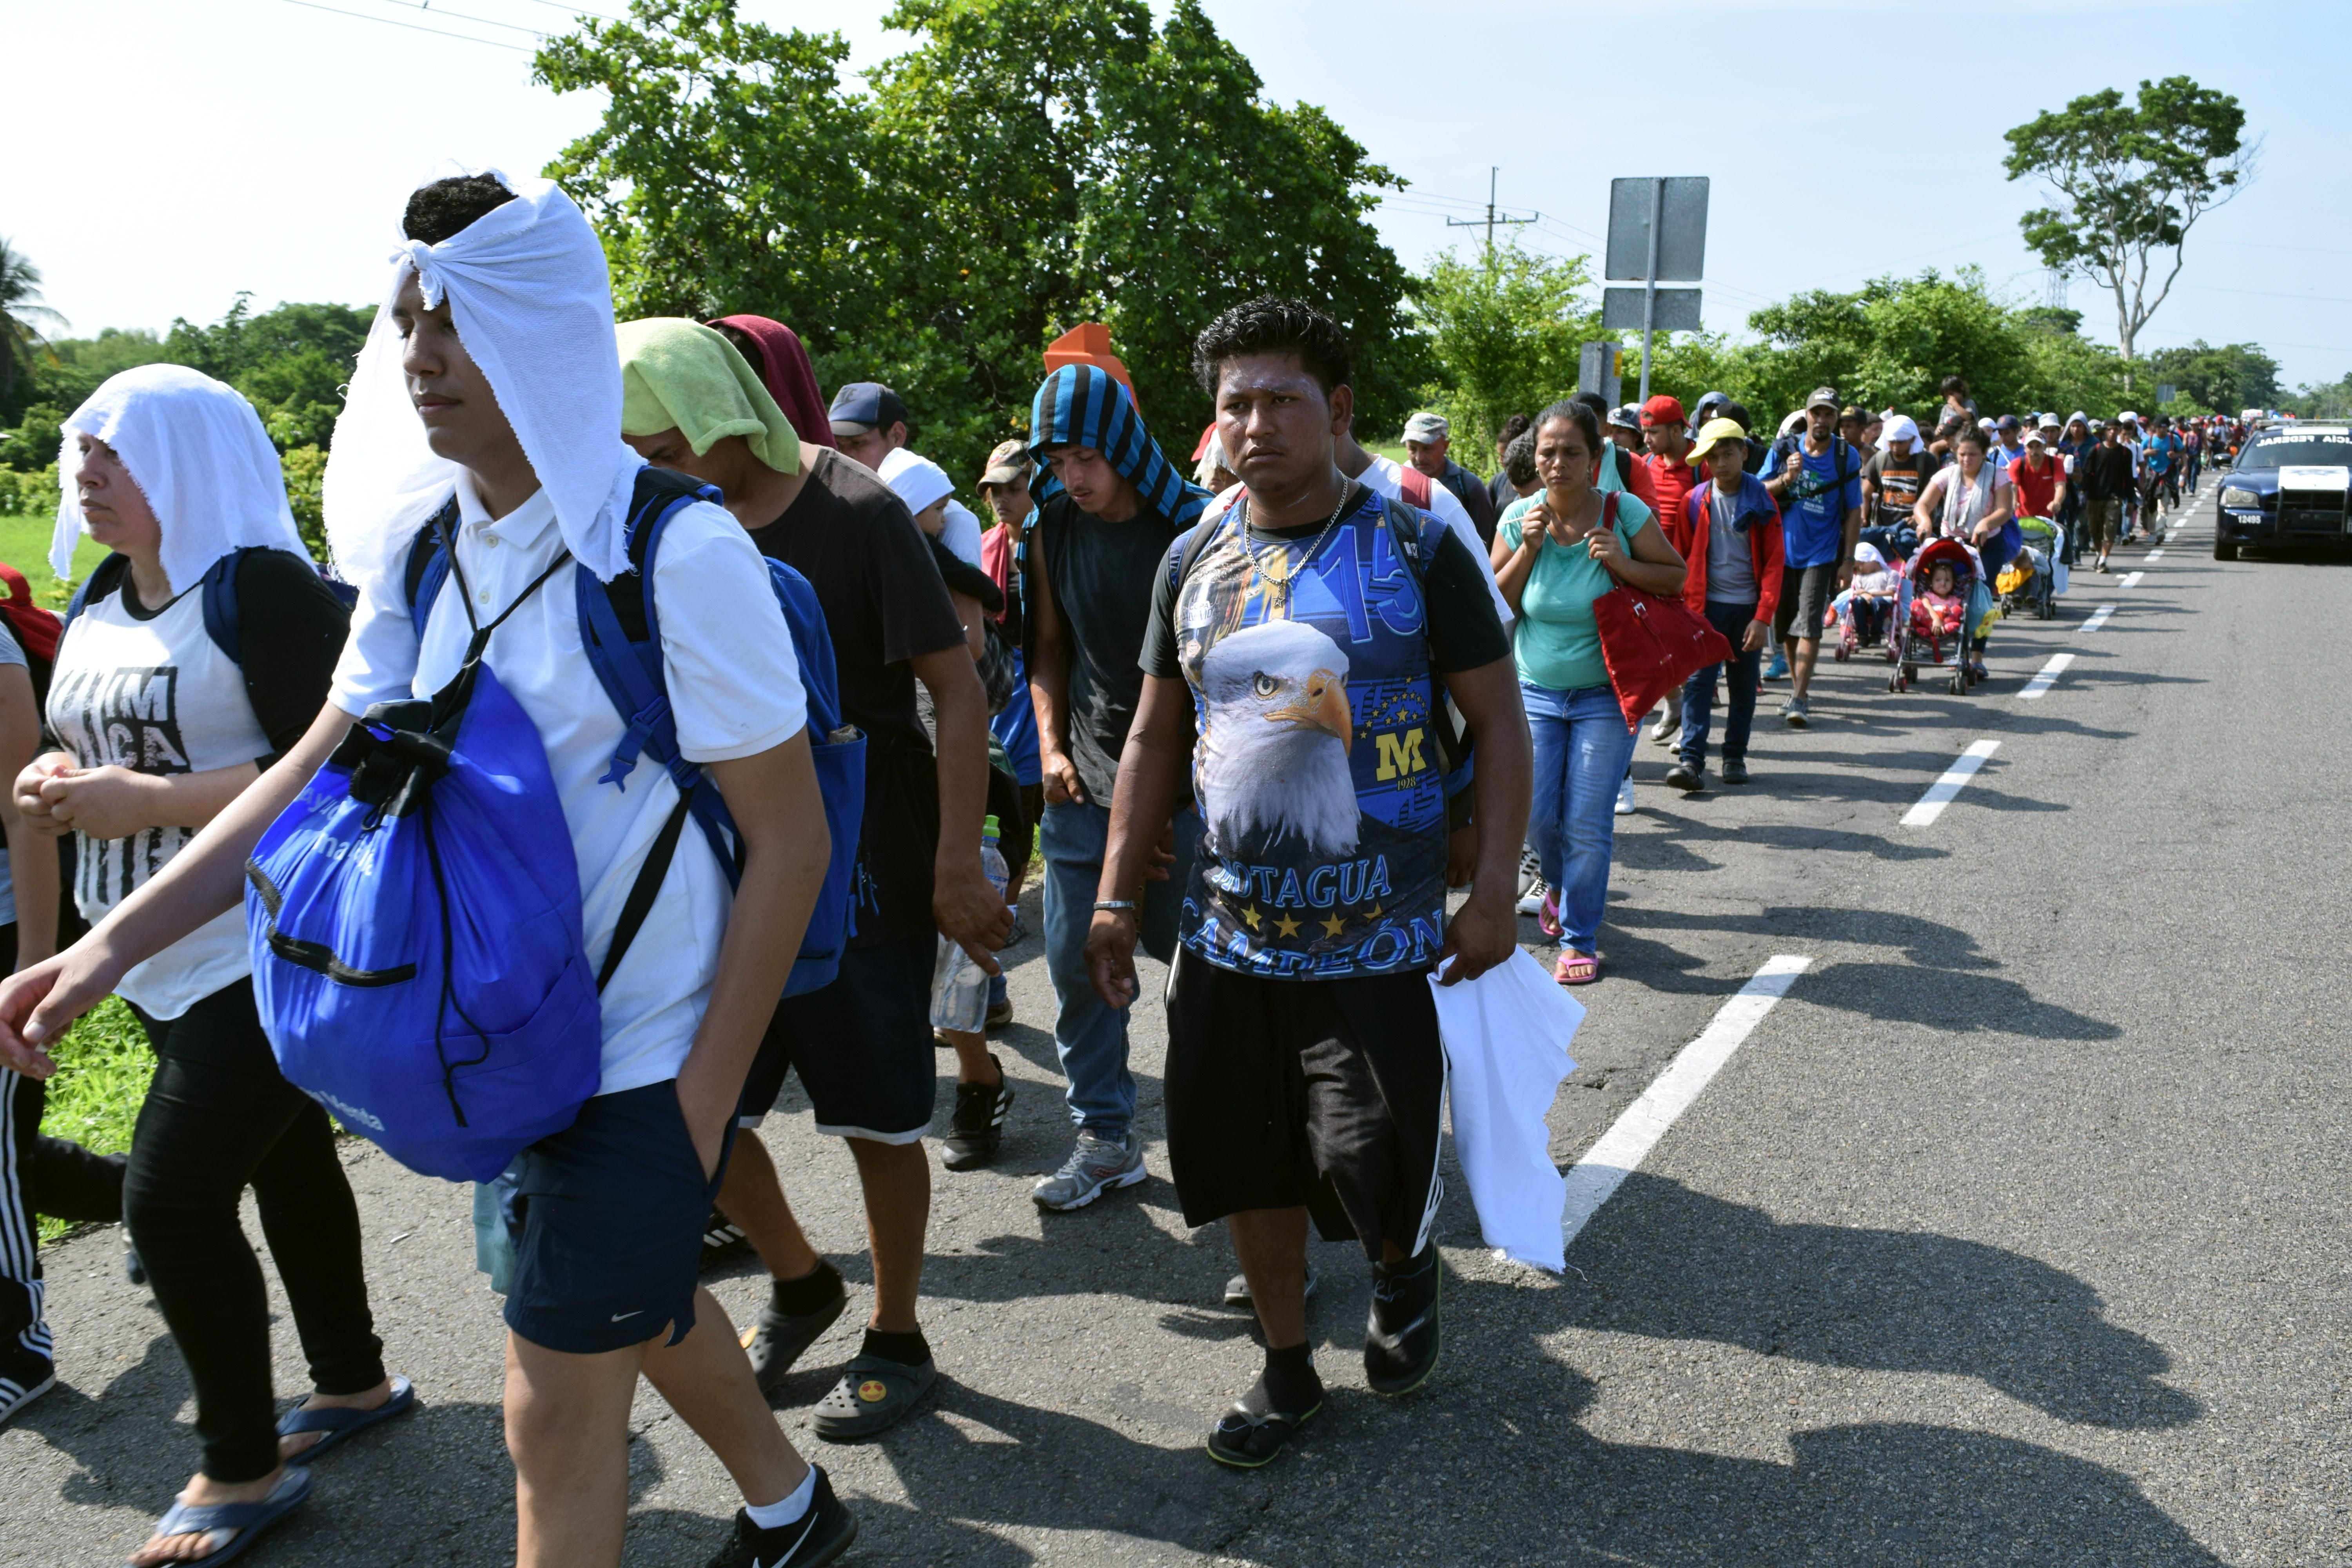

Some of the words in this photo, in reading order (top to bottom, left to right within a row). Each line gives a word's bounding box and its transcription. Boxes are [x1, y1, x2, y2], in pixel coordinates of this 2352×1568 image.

[2238, 515, 2261, 524] 12495
[1318, 524, 1424, 644] 15
[1376, 728, 1426, 781] M
[1397, 776, 1416, 791] 1928
